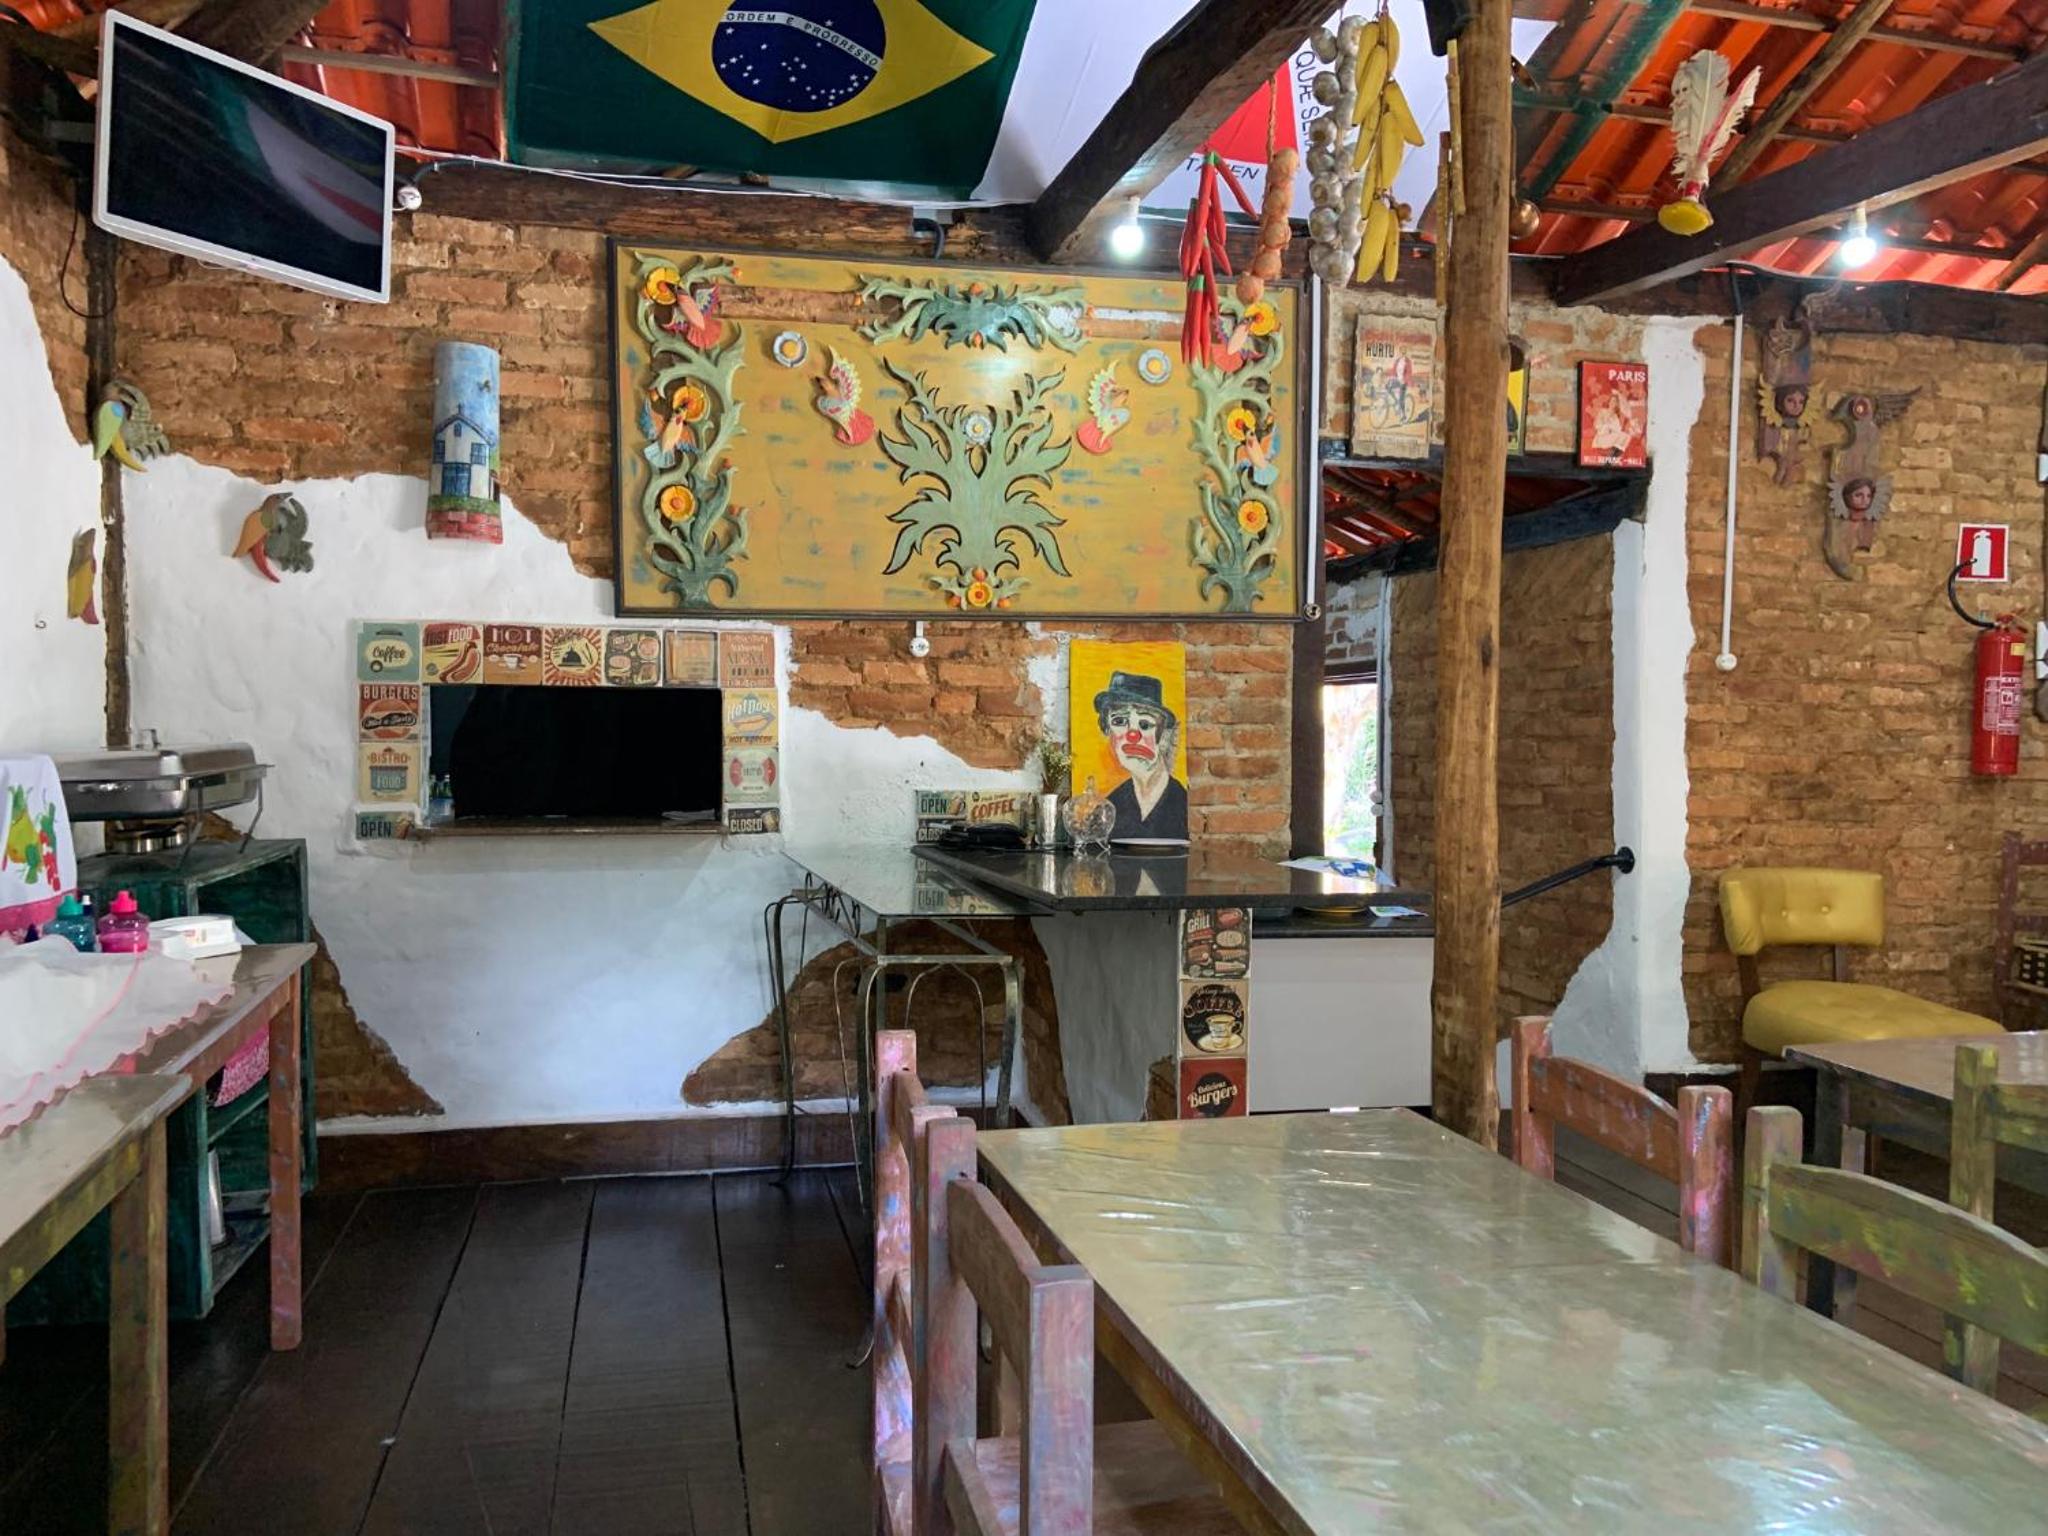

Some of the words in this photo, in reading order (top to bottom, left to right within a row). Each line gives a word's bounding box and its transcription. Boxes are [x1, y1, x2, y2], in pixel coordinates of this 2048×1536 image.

[726, 12, 776, 22] ORDEM
[786, 16, 795, 25] E
[803, 23, 878, 66] PROGRESSO
[1608, 369, 1646, 383] PARIS
[448, 626, 473, 643] FOOD
[492, 627, 534, 643] HOT
[373, 645, 406, 662] Coffee
[363, 686, 417, 700] BURGERS
[370, 752, 408, 763] BISTRO
[920, 798, 947, 814] OPEN
[971, 798, 1016, 820] COFFEE
[360, 821, 392, 838] OPEN
[730, 818, 763, 832] CLOSED
[1187, 914, 1210, 933] GRILL
[1187, 1084, 1238, 1109] Burgers
